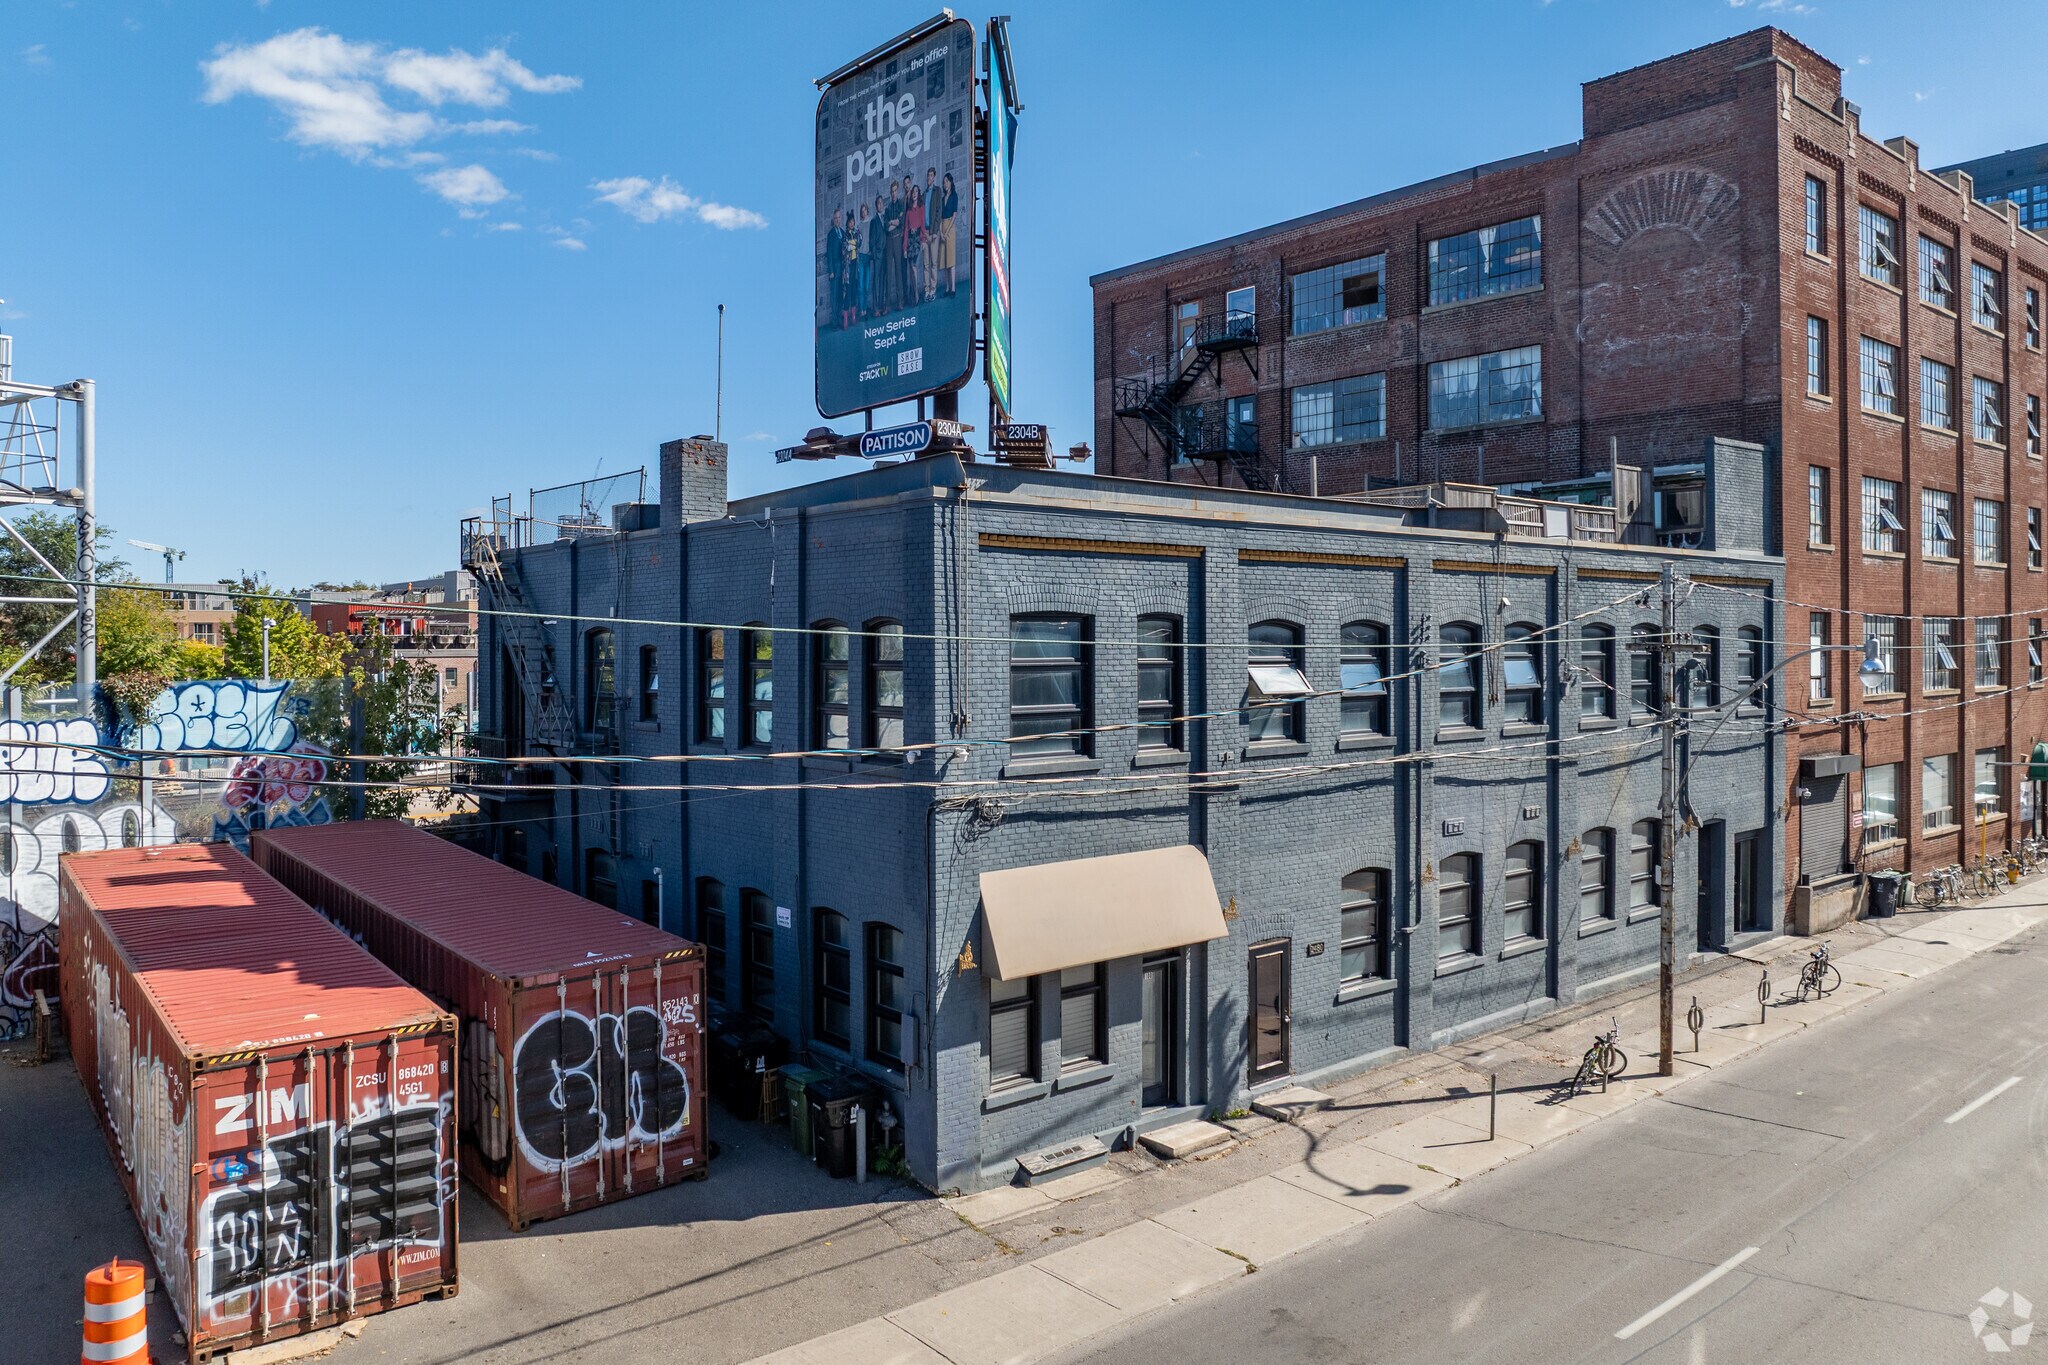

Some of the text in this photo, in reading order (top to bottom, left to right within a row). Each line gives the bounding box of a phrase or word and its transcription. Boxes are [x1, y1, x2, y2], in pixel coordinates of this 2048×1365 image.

[849, 94, 857, 102] THE
[857, 87, 869, 97] CREW
[870, 82, 880, 92] THAT
[910, 57, 924, 71] the
[924, 45, 948, 64] office
[864, 92, 916, 142] the
[846, 114, 937, 195] paper
[864, 316, 916, 339] New Series
[874, 331, 906, 349] Sept 4
[900, 349, 920, 363] SHOW
[859, 365, 889, 382] STACKTV
[900, 361, 919, 374] CASE
[938, 421, 962, 437] 2304A
[1008, 425, 1039, 439] 2304B
[865, 428, 925, 452] PATTISON
[355, 1071, 387, 1089] ZCSU
[398, 1063, 434, 1080] 868420
[399, 1081, 423, 1096] 45G1
[214, 1083, 310, 1135] ZIM
[399, 1247, 441, 1265] WW.ZIM.COM
